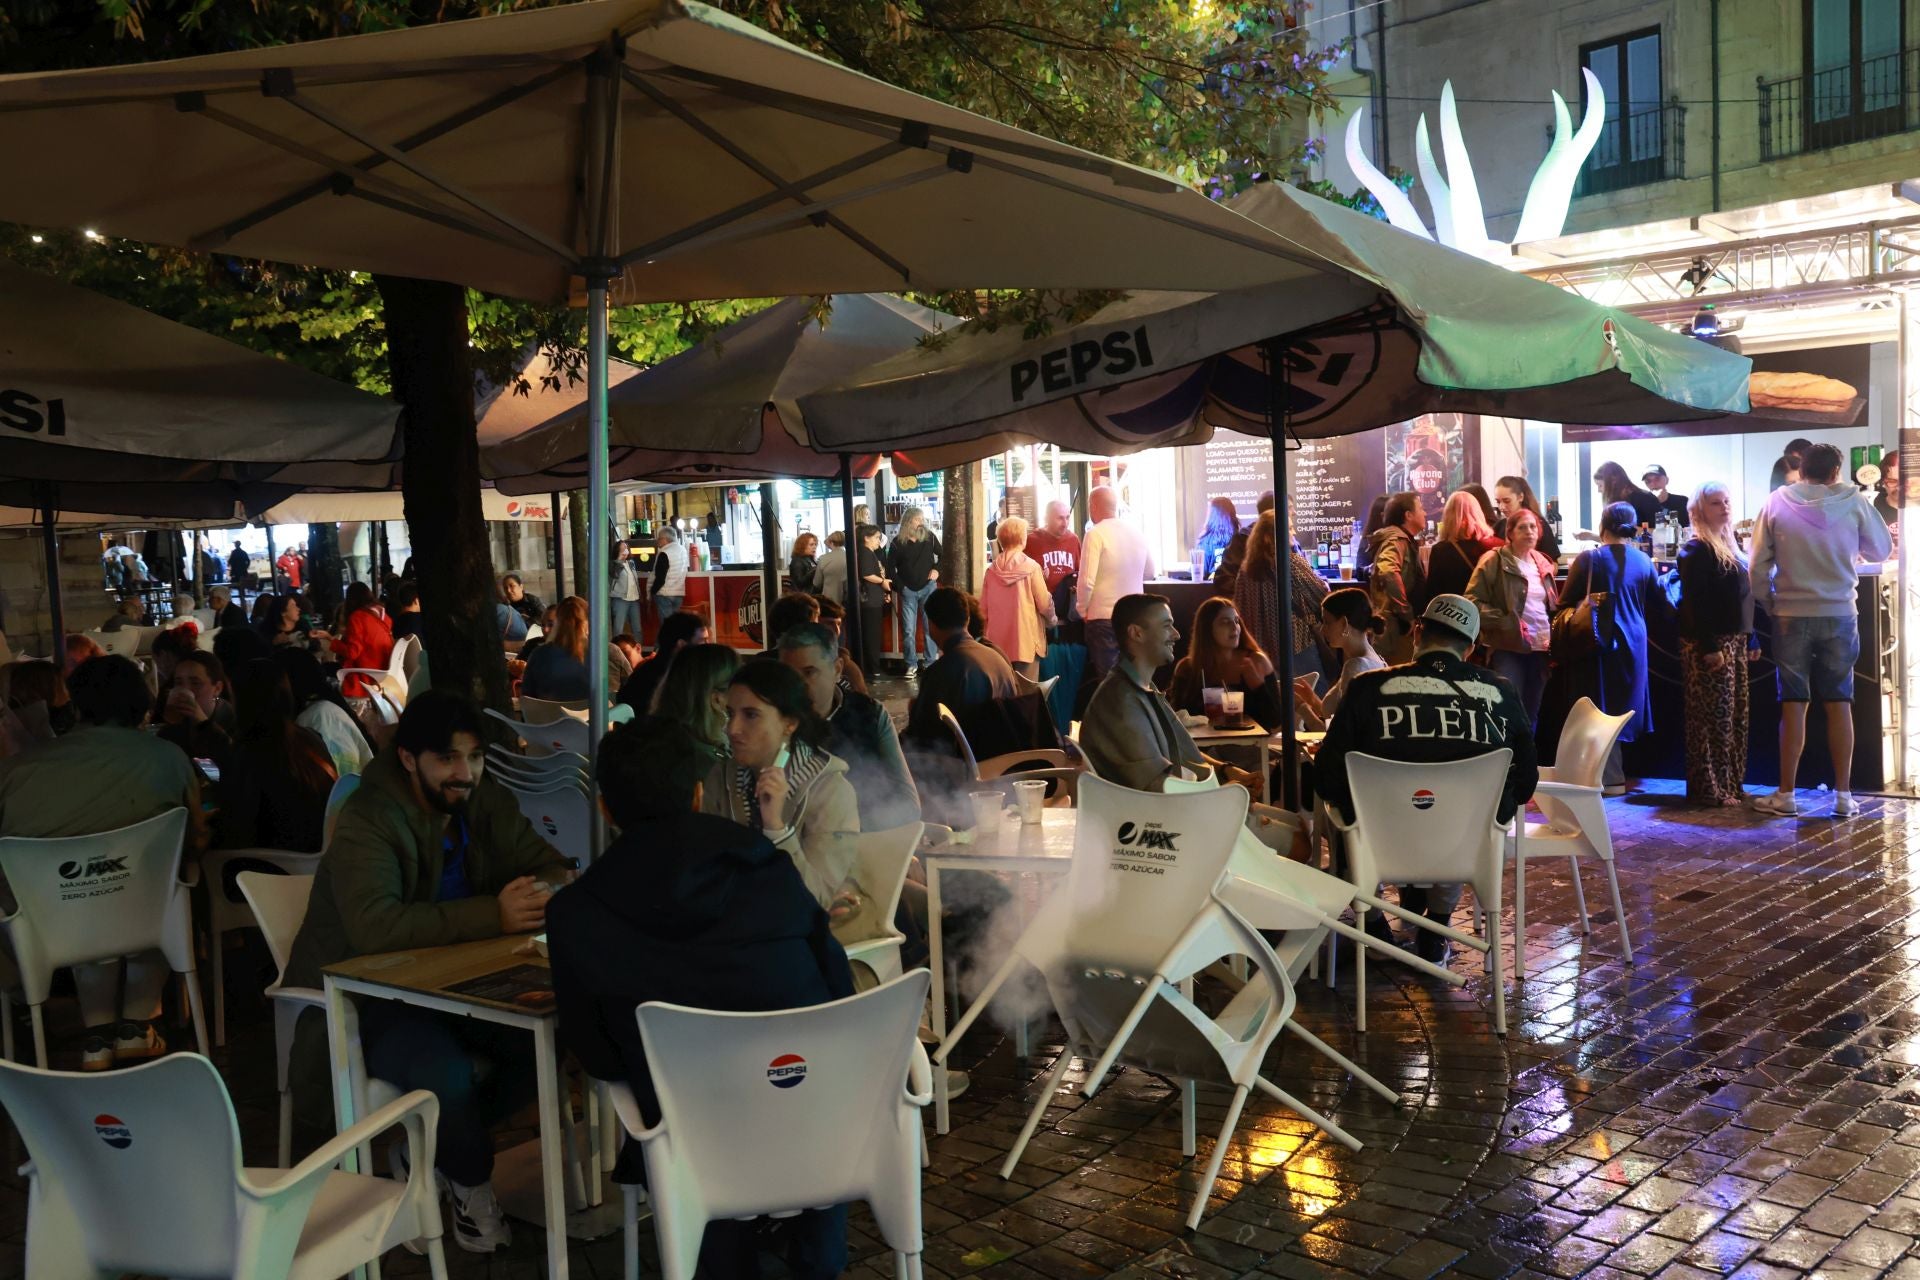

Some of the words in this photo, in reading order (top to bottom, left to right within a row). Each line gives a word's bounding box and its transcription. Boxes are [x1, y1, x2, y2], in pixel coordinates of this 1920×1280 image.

[1011, 326, 1154, 402] PEPSI
[1042, 550, 1074, 570] PUMA
[1434, 601, 1470, 627] Vans
[1378, 704, 1514, 745] PLEIN
[1136, 829, 1182, 852] MAX
[85, 856, 129, 877] MAX
[1147, 852, 1177, 862] SABOR
[62, 892, 87, 901] ZERO
[767, 1065, 807, 1078] PEPSI
[95, 1126, 132, 1138] PEPSI
